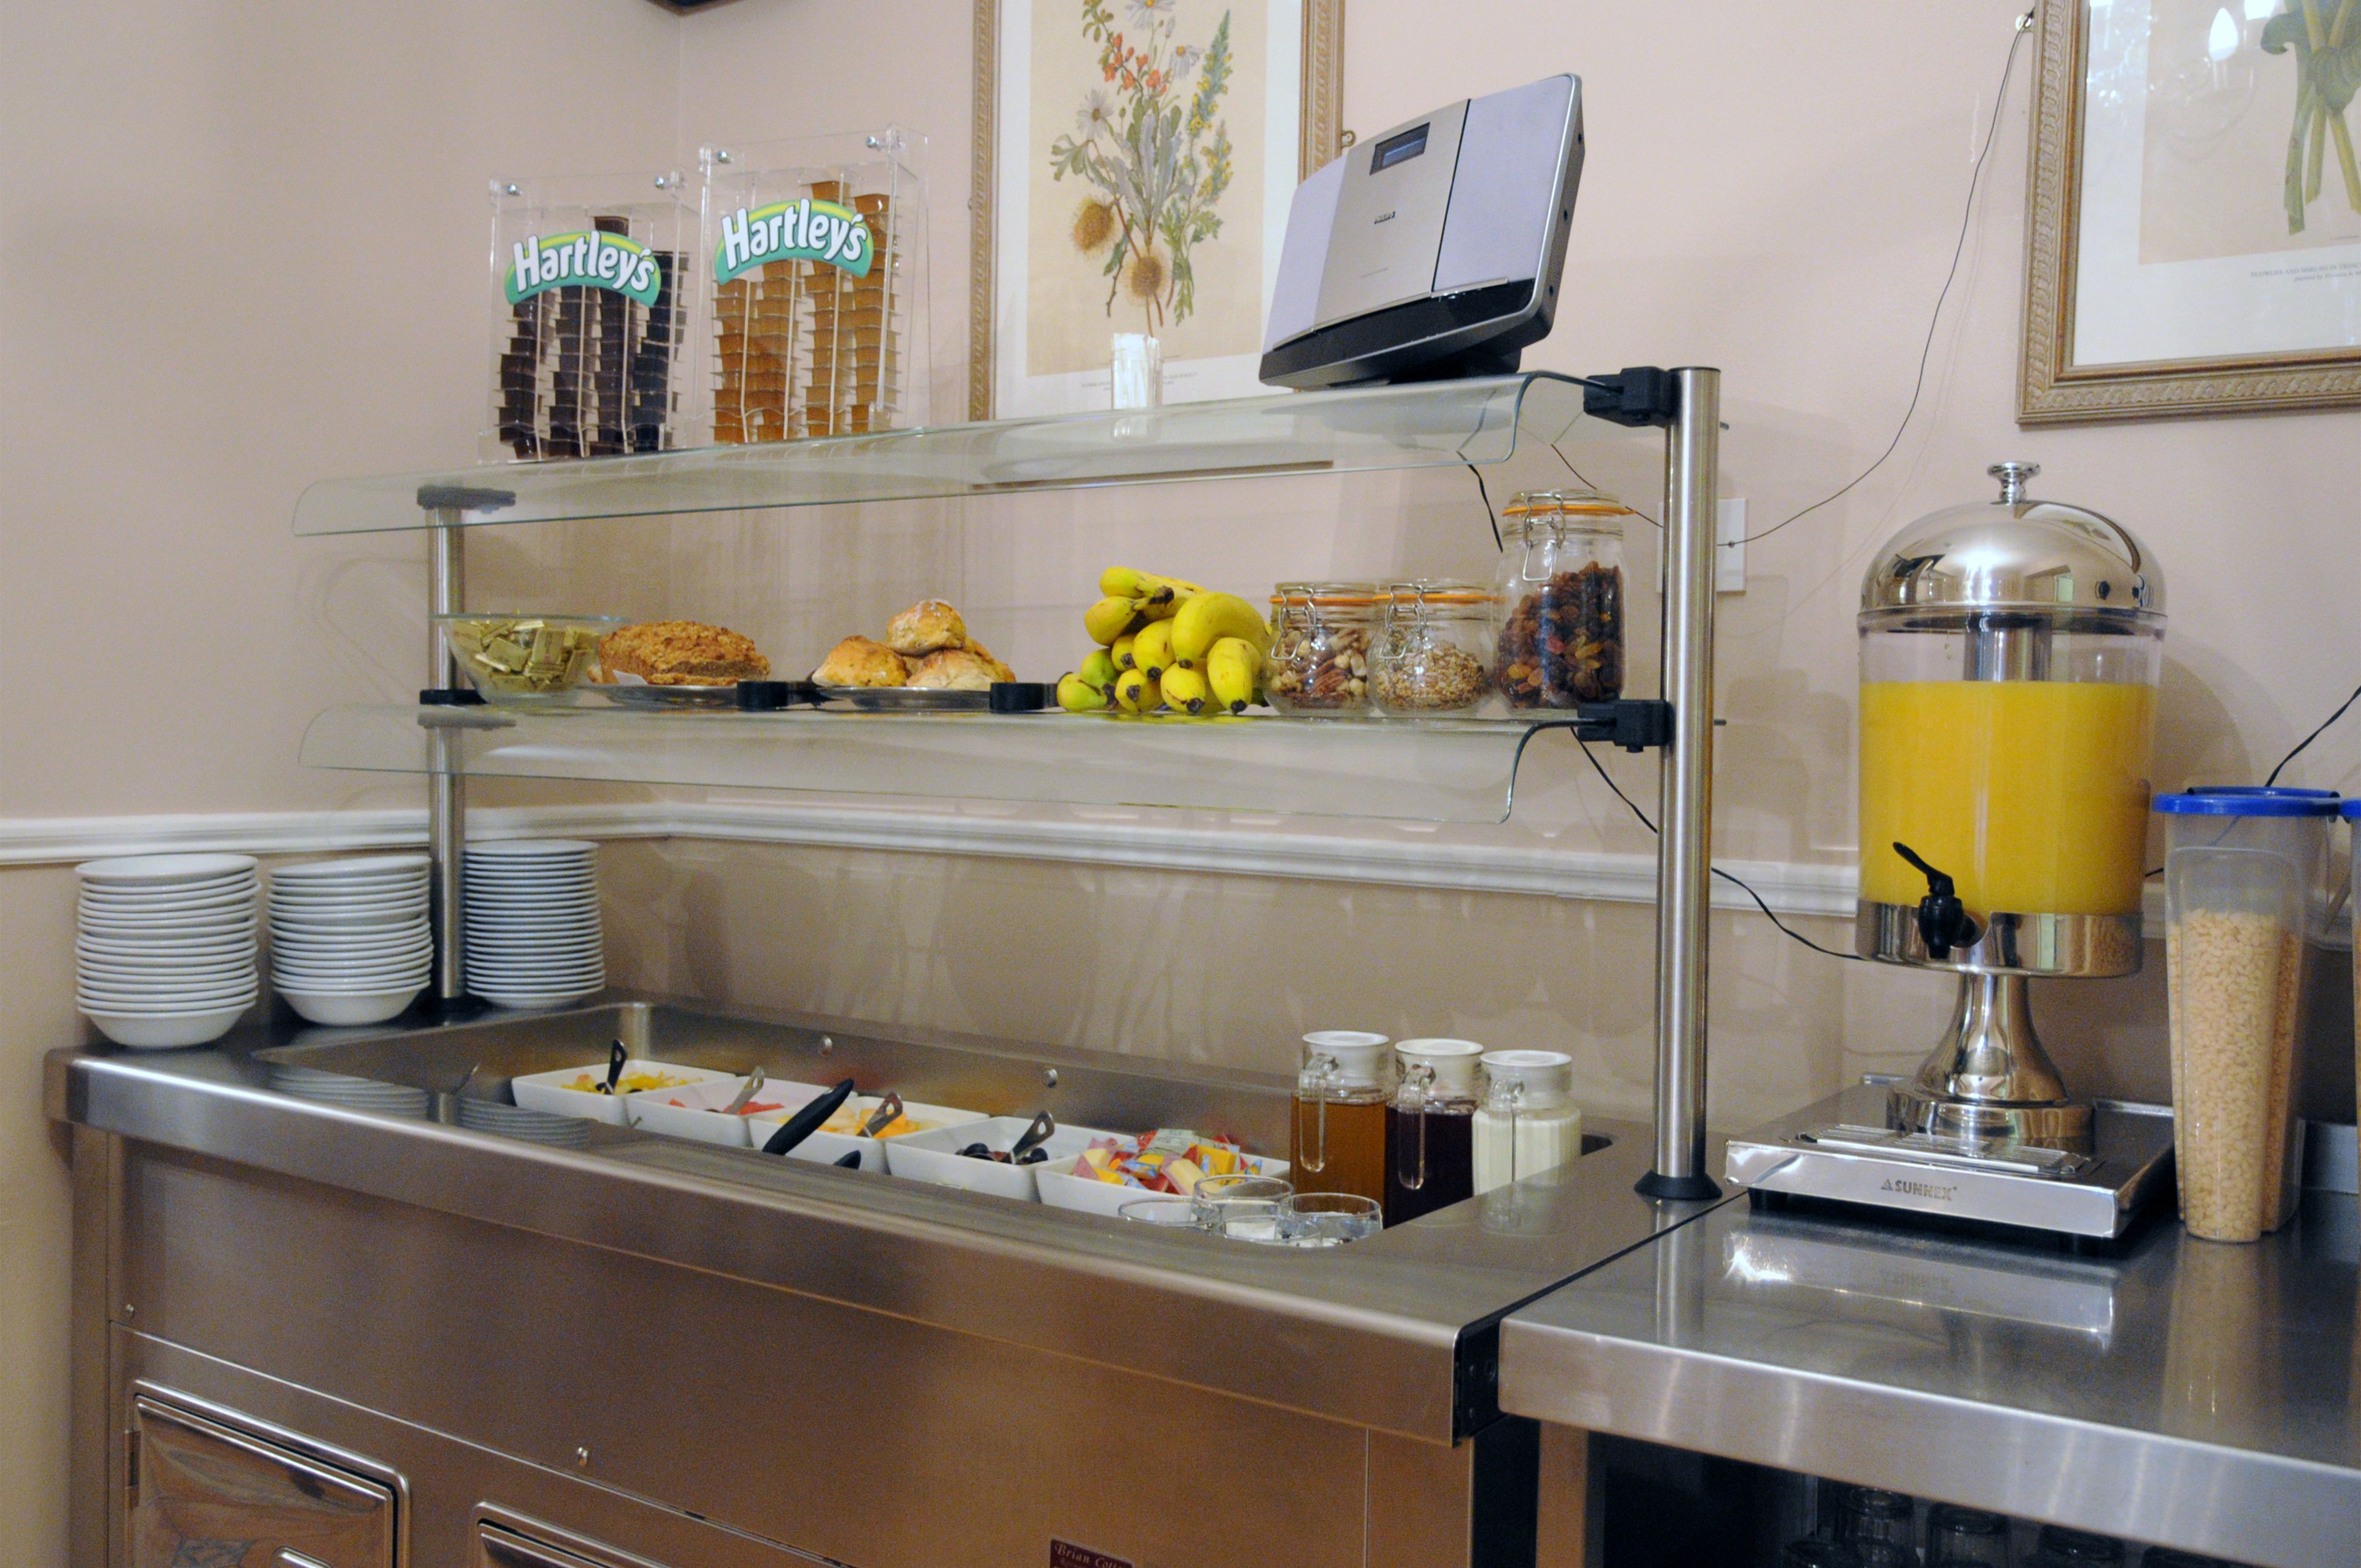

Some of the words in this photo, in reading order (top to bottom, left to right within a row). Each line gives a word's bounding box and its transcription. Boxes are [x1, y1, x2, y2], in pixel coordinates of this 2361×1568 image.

[721, 198, 868, 272] Hartley's
[513, 230, 655, 293] Hartley's
[1894, 1179, 1953, 1201] SUNNEX
[1054, 1543, 1090, 1564] Brian
